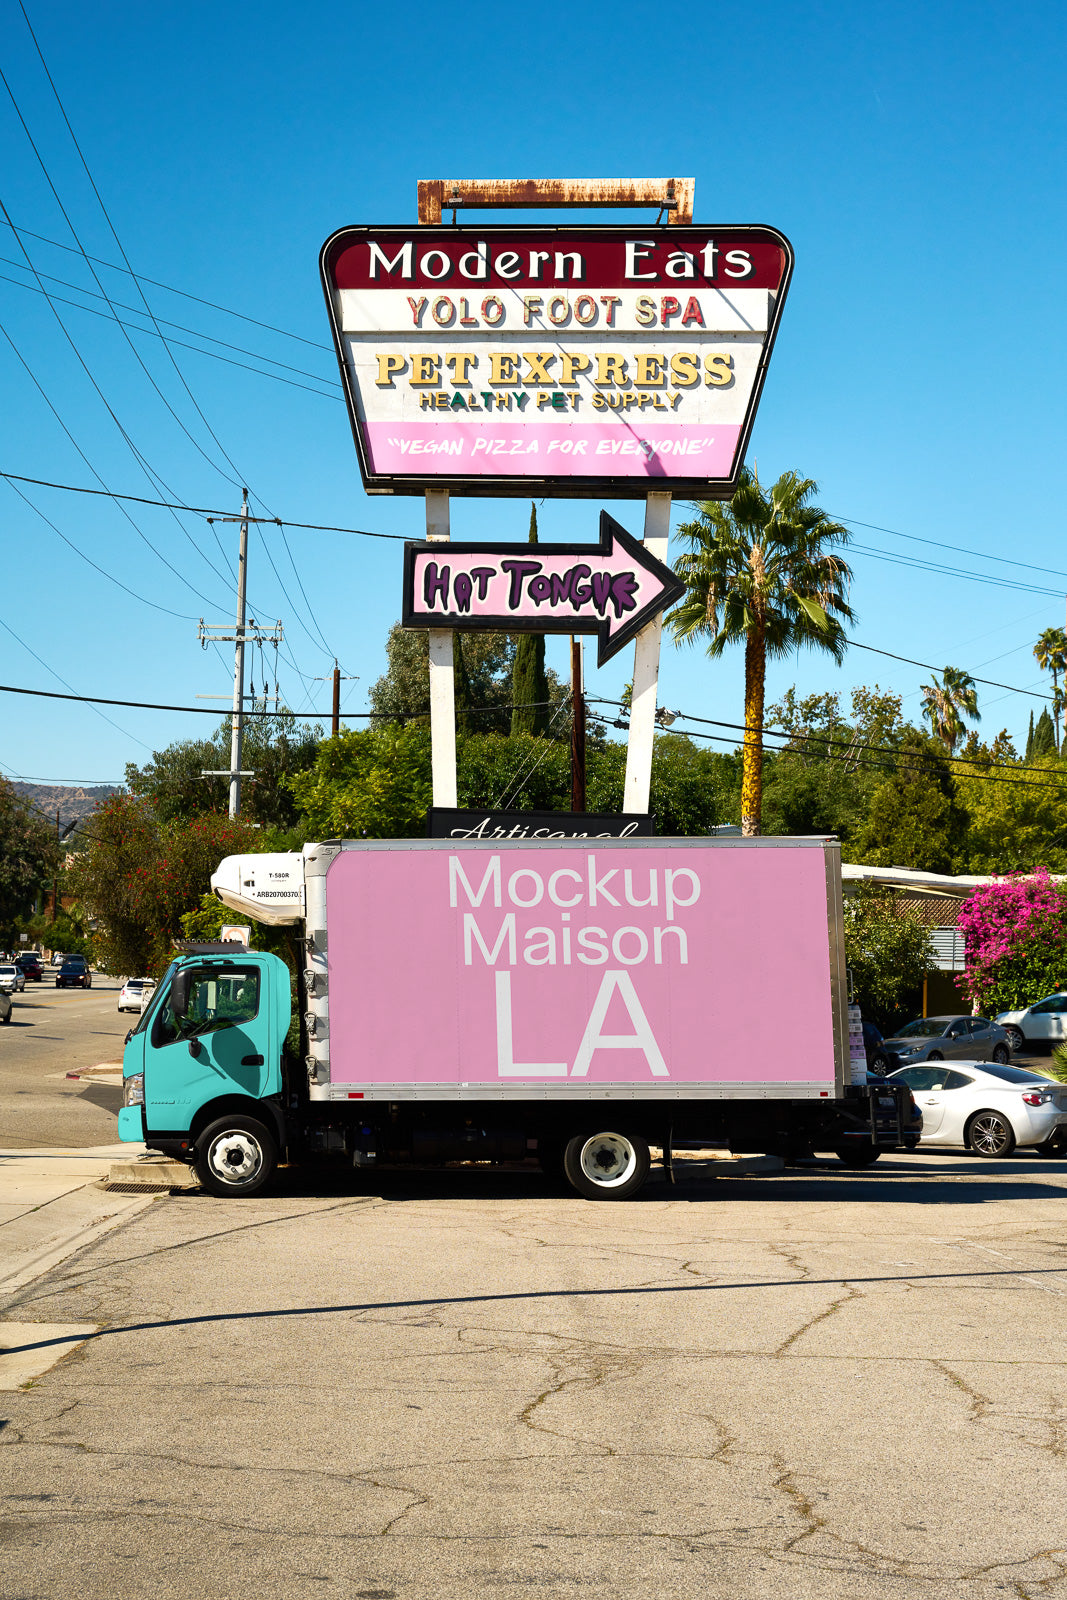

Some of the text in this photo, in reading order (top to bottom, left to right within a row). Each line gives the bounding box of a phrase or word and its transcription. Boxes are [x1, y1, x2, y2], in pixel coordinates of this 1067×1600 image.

[367, 240, 753, 279] Modern Eats
[407, 295, 705, 325] YOLO FOOT SPA
[375, 352, 736, 386] PET EXPRESS
[419, 391, 685, 409] HEALTHY PET SUPPLY
[470, 437, 539, 457] PIZZA
[547, 439, 589, 456] FOR
[423, 559, 640, 619] HOT TONGUE
[448, 854, 702, 921] Mockup
[463, 912, 689, 966] Maison
[495, 969, 671, 1077] LA
